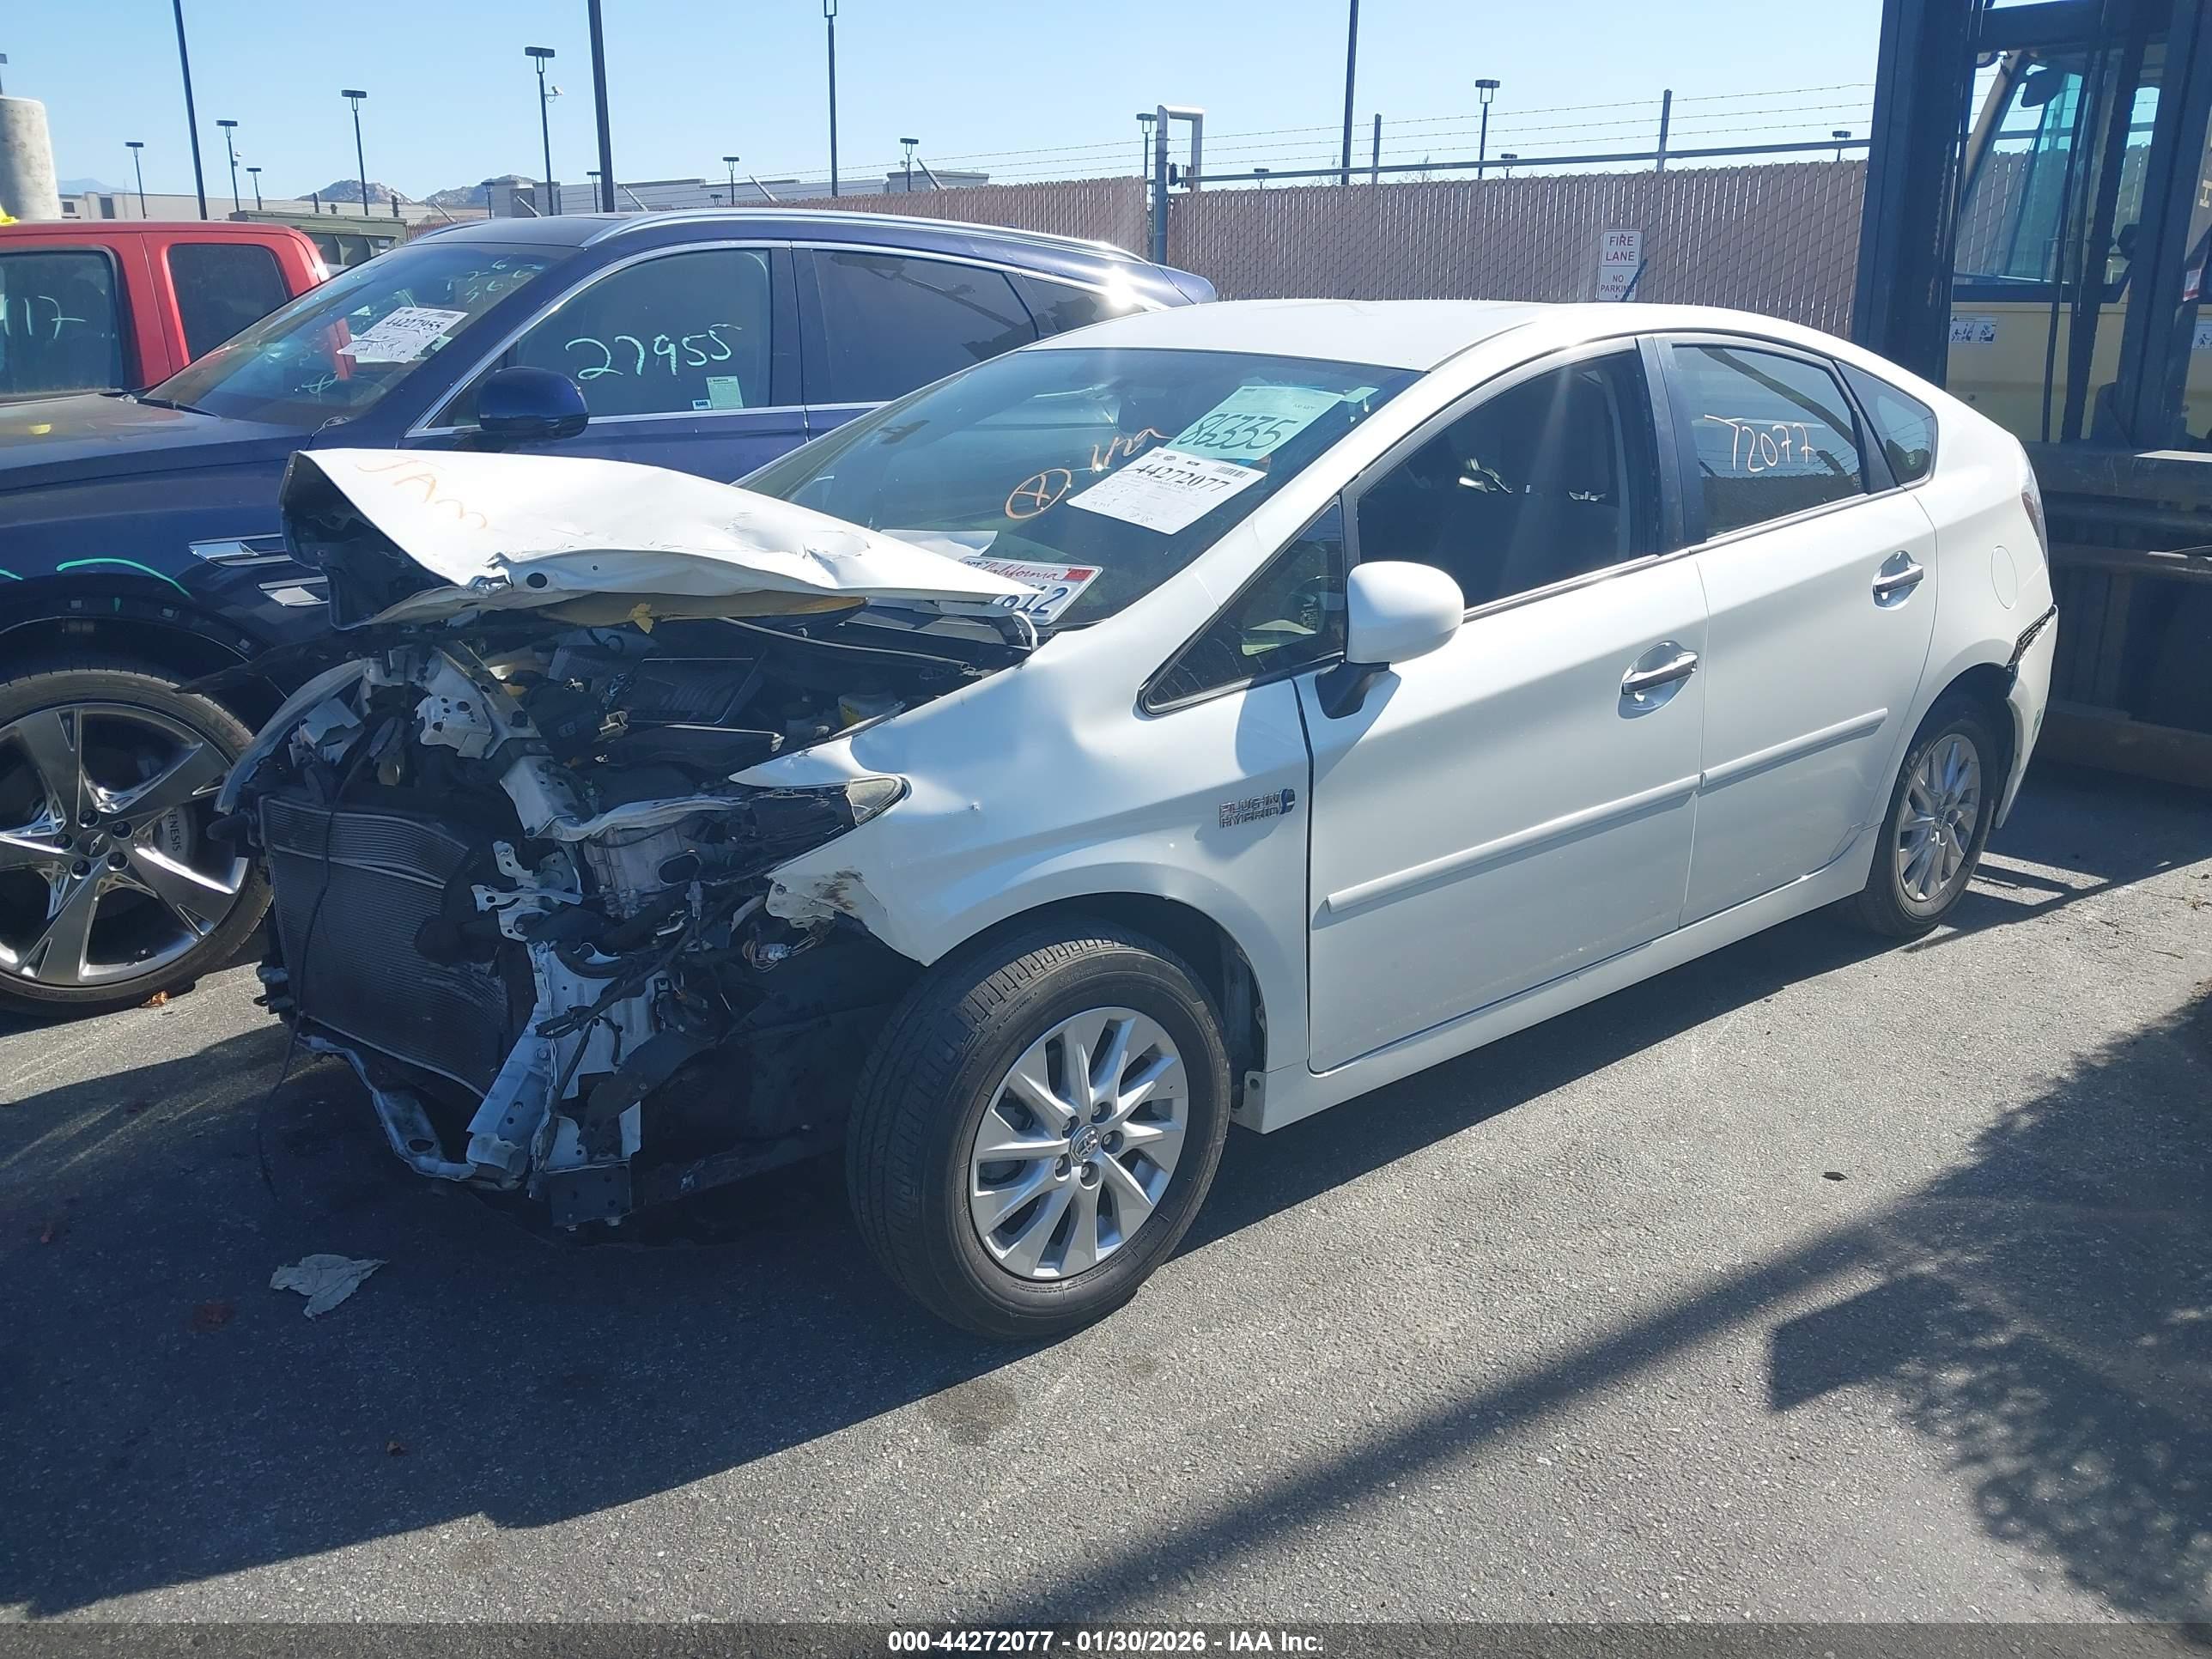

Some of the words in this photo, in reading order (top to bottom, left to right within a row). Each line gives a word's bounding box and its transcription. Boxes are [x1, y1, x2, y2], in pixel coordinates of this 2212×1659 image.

[1609, 236, 1634, 246] FIRE
[1606, 252, 1635, 262] LANE
[565, 323, 743, 380] 27955
[1176, 413, 1299, 451] 86335
[1705, 414, 1815, 473] 72077
[1135, 463, 1232, 493] 44272077
[1219, 805, 1280, 828] HYBRID
